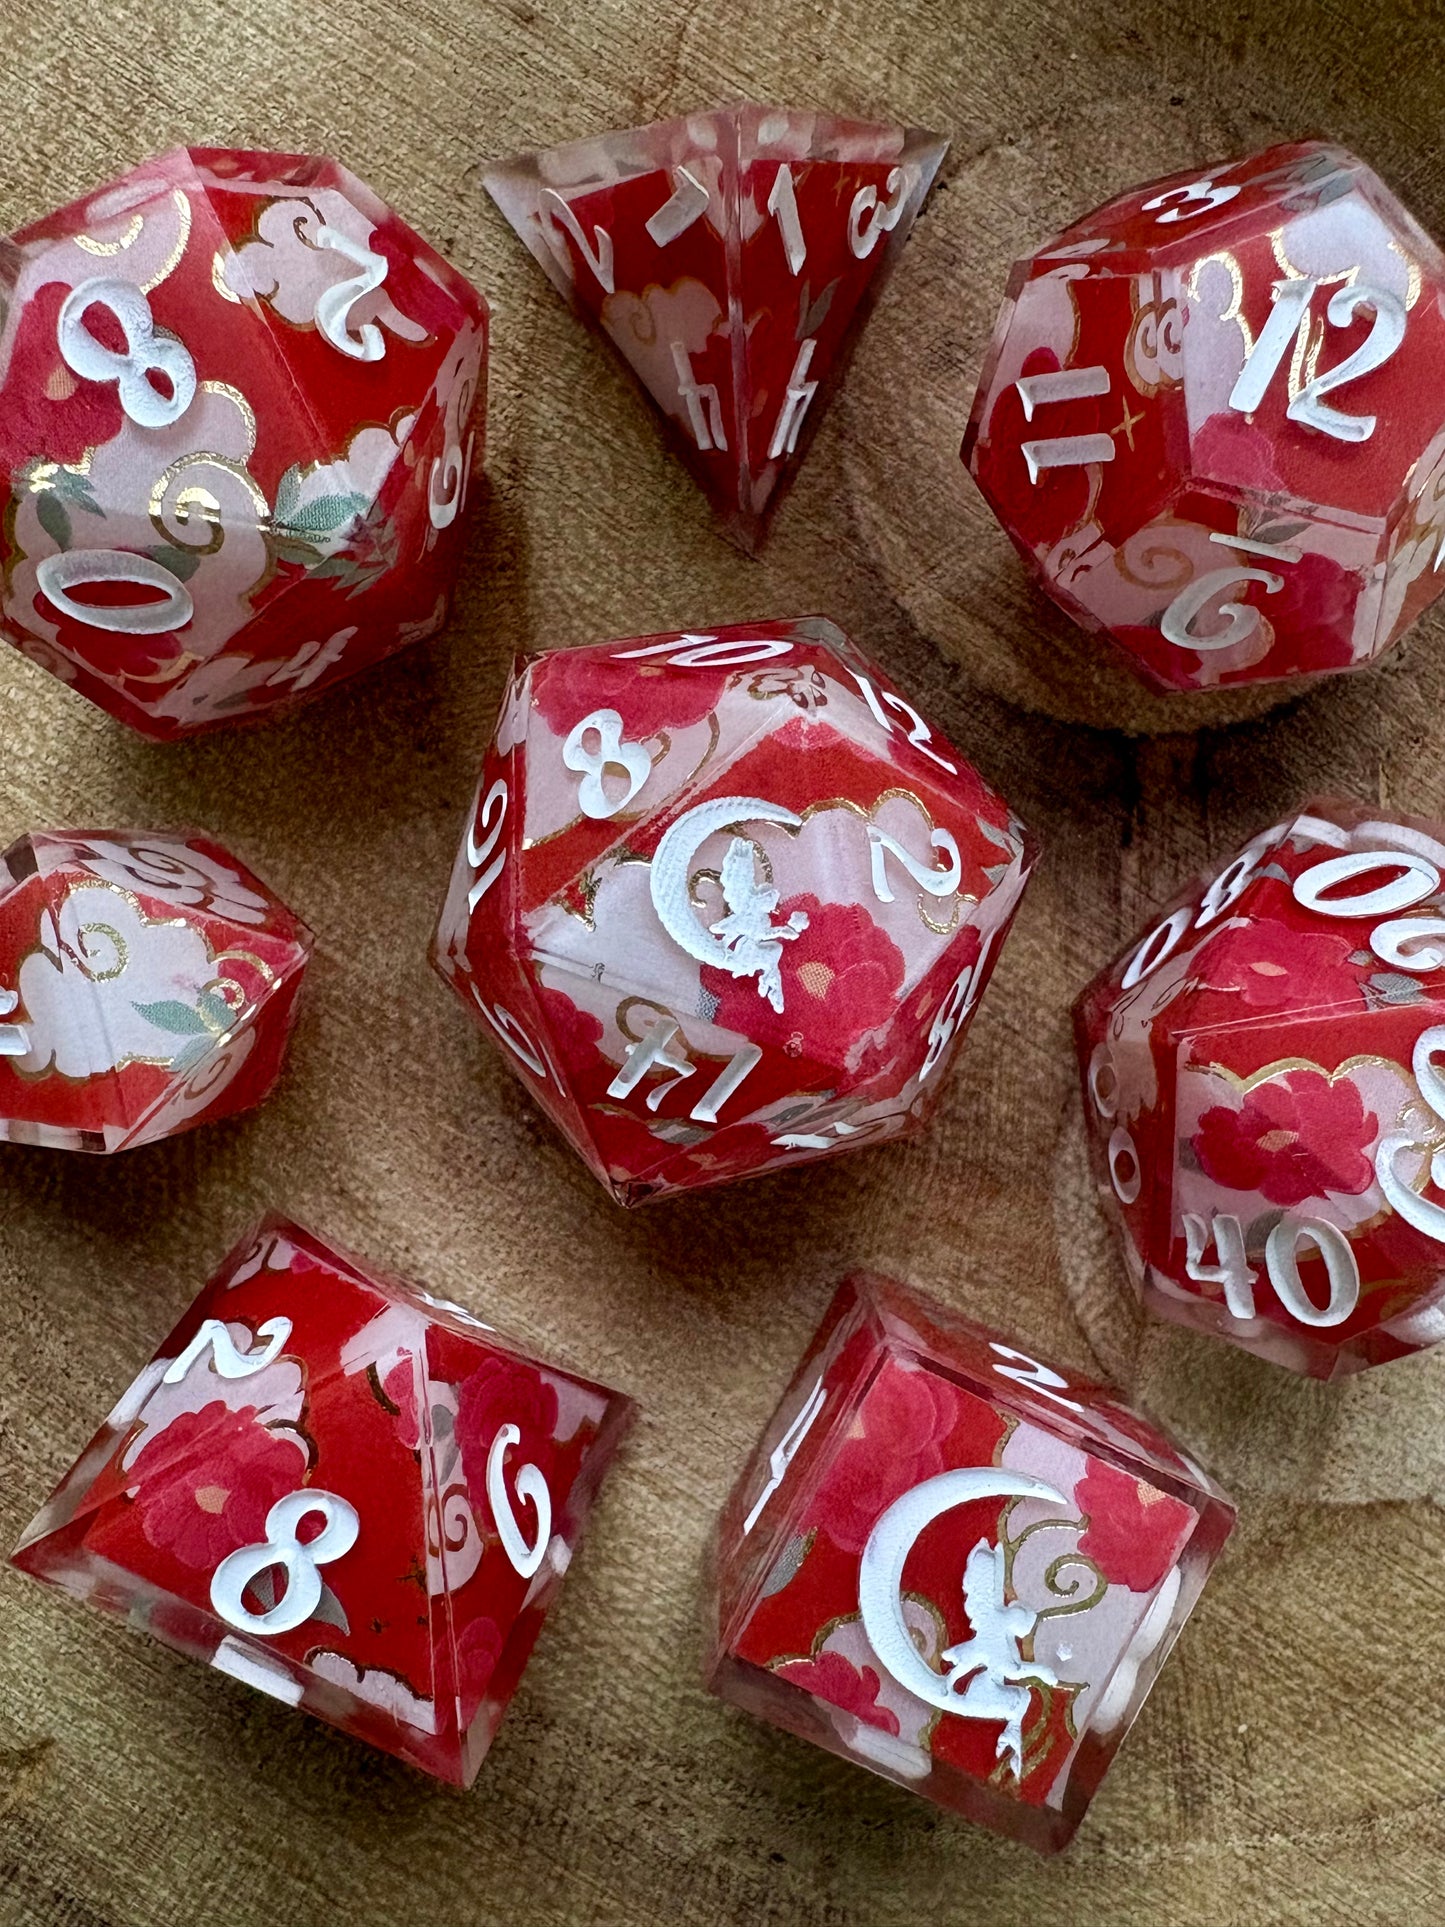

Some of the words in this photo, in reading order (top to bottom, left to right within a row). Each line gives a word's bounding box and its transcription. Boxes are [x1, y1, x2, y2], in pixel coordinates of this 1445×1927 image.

[314, 225, 388, 361] 2
[58, 277, 196, 428] 8
[1228, 277, 1407, 443] 12
[36, 549, 194, 634] 0
[610, 634, 794, 666] 10
[563, 709, 651, 818] 8
[844, 665, 957, 775] 12
[867, 827, 960, 902] 2
[1182, 1213, 1360, 1326] 40
[163, 1317, 293, 1384] 2
[989, 1341, 1085, 1413] 2
[487, 1423, 552, 1579] 6
[210, 1489, 360, 1635] 8
